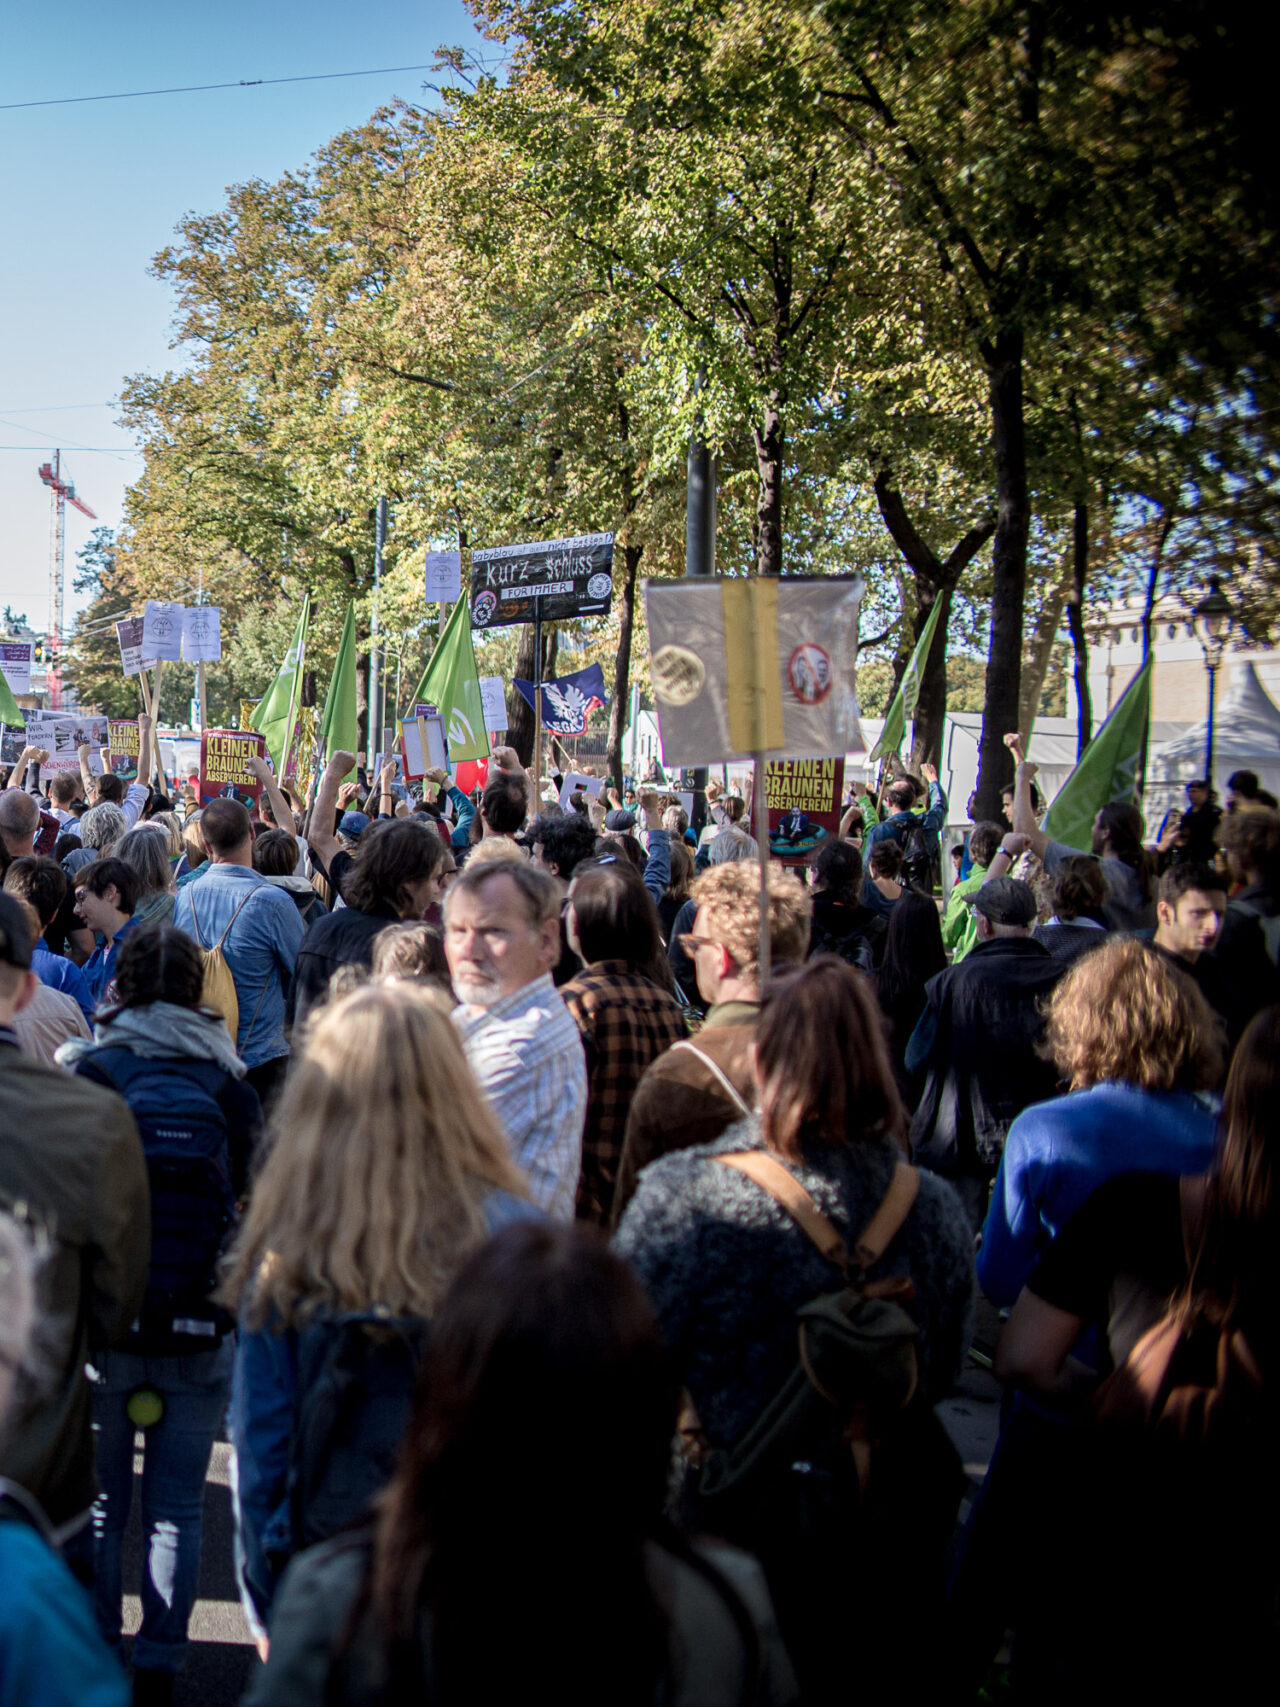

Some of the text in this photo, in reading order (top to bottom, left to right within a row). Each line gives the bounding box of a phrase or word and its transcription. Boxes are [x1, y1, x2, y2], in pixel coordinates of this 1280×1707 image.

[487, 550, 592, 586] kurz schluss
[530, 582, 567, 595] IMMER
[29, 724, 43, 732] WIR
[109, 725, 139, 737] KLEINE
[110, 736, 139, 749] RAUNE
[206, 737, 259, 758] KLEINEN
[206, 754, 250, 774] BRAUNE
[206, 770, 257, 786] ABSERVIEREN!
